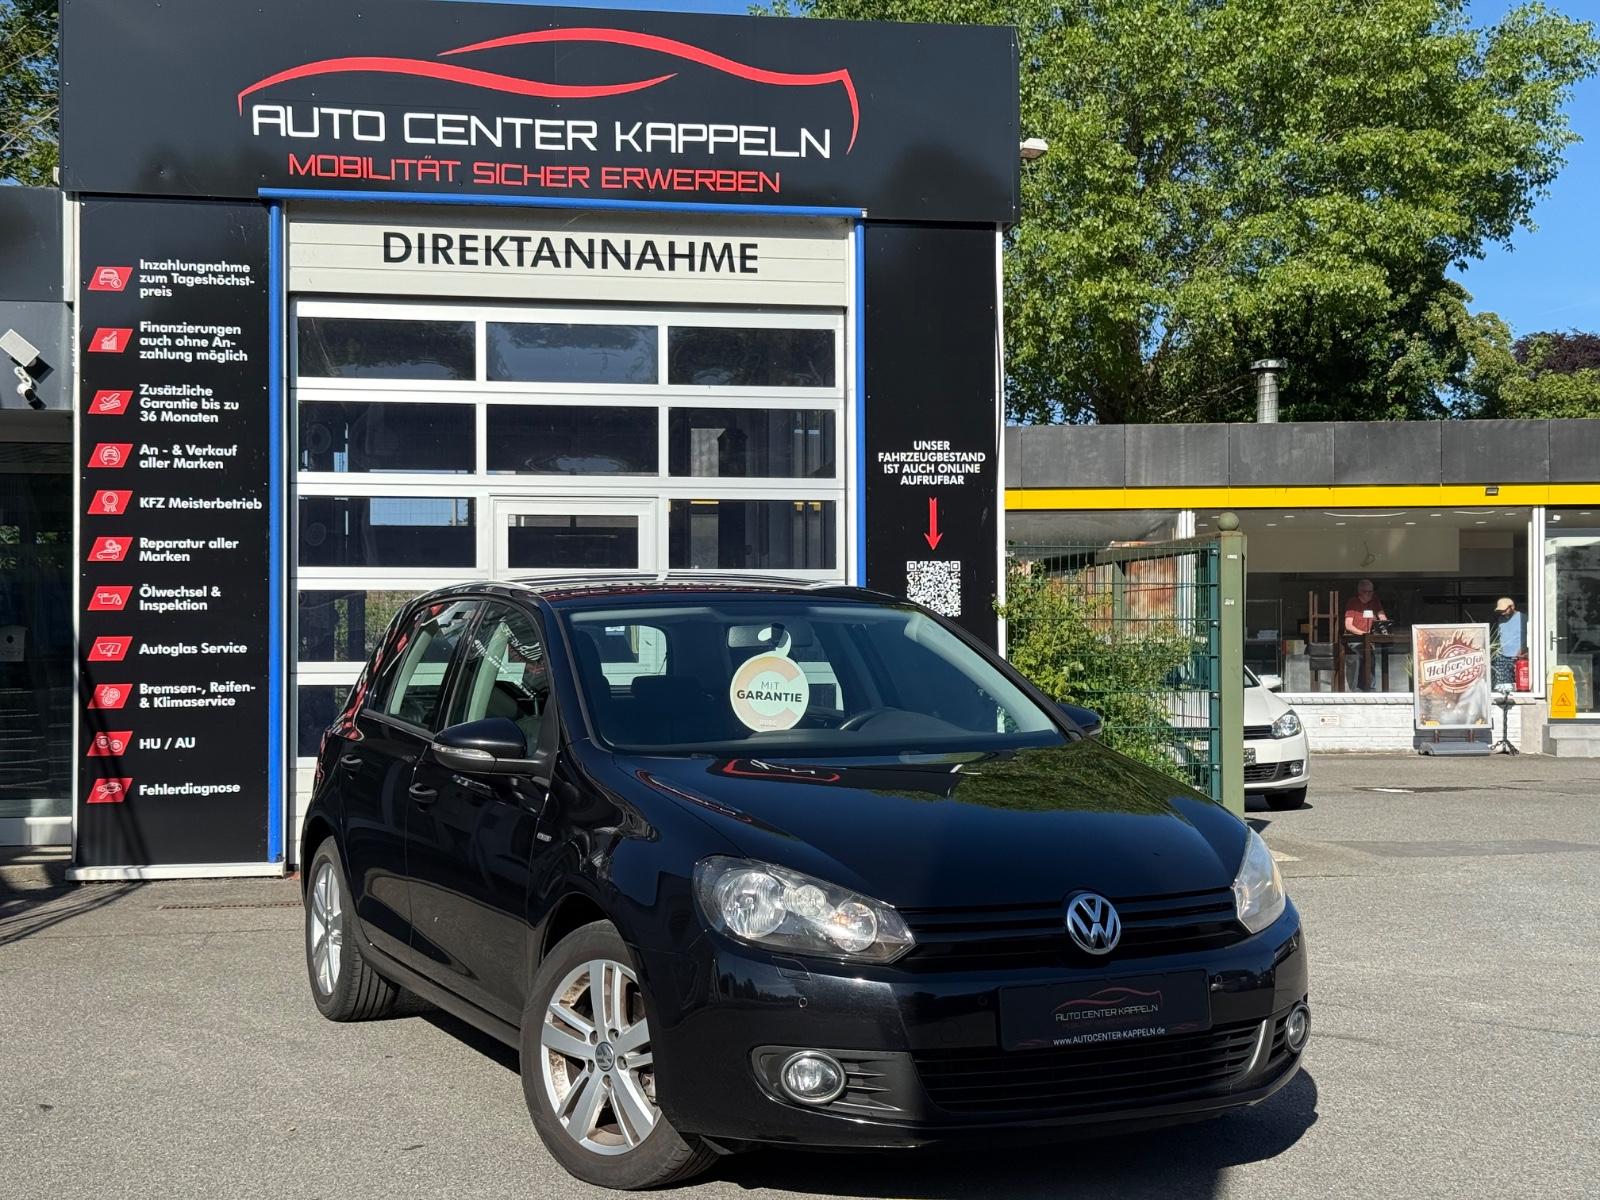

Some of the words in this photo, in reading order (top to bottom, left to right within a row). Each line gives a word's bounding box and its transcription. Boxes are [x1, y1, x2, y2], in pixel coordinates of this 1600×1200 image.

[252, 104, 386, 142] AUTO
[403, 112, 598, 152] CENTER
[614, 120, 831, 159] KAPPELN
[287, 155, 462, 182] MOBILITÄT
[473, 161, 590, 187] SICHER
[600, 167, 780, 193] ERWERBEN
[383, 231, 759, 274] DIREKTANNAHME
[139, 259, 251, 274] Inzahlungnahme
[138, 274, 168, 284] zum
[171, 272, 255, 287] Tageshöchst-
[140, 285, 172, 298] preis
[139, 320, 242, 337] Finanzierungen
[139, 334, 172, 347] auch
[174, 334, 209, 348] ohne
[211, 335, 237, 348] An-
[139, 347, 193, 363] zahlung
[196, 348, 248, 364] möglich
[139, 383, 214, 397] Zusätzliche
[139, 396, 199, 410] Garantie
[201, 397, 221, 410] bis
[223, 401, 240, 411] zu
[139, 410, 158, 422] 36
[160, 410, 219, 423] Monaten
[171, 444, 183, 456] &
[184, 444, 238, 457] Verkauf
[913, 440, 951, 451] UNSER
[139, 456, 171, 469] aller
[172, 457, 224, 470] Marken
[877, 451, 986, 463] FAHRZEUGBESTAND
[883, 463, 900, 474] IST
[901, 463, 935, 474] AUCH
[937, 463, 981, 474] ONLINE
[899, 474, 965, 486] AUFRUFBAR
[139, 496, 166, 509] KFZ
[168, 496, 263, 510] Meisterbetrieb
[139, 537, 206, 553] Reparatur
[208, 536, 240, 549] aller
[138, 549, 191, 562] Marken
[139, 583, 208, 598] Ölwechsel
[210, 585, 222, 598] &
[139, 598, 208, 614] Inspektion
[138, 642, 199, 657] Autoglas
[200, 641, 248, 654] Service
[139, 683, 207, 696] Bremsen-,
[209, 680, 256, 693] Reifen-
[760, 680, 780, 691] MIT
[138, 696, 151, 709] &
[153, 694, 236, 708] Klimaservice
[736, 689, 802, 703] GARANTIE
[139, 737, 162, 750] HU
[163, 737, 173, 751] /
[174, 736, 196, 749] AU
[139, 782, 241, 797] Fehlerdiagnose
[1055, 1010, 1080, 1022] AUTO
[1081, 1007, 1117, 1020] CENTER
[1118, 1004, 1159, 1016] KAPPELN
[1053, 1026, 1166, 1046] www.AUTOCENTER-KAPPELN.de
